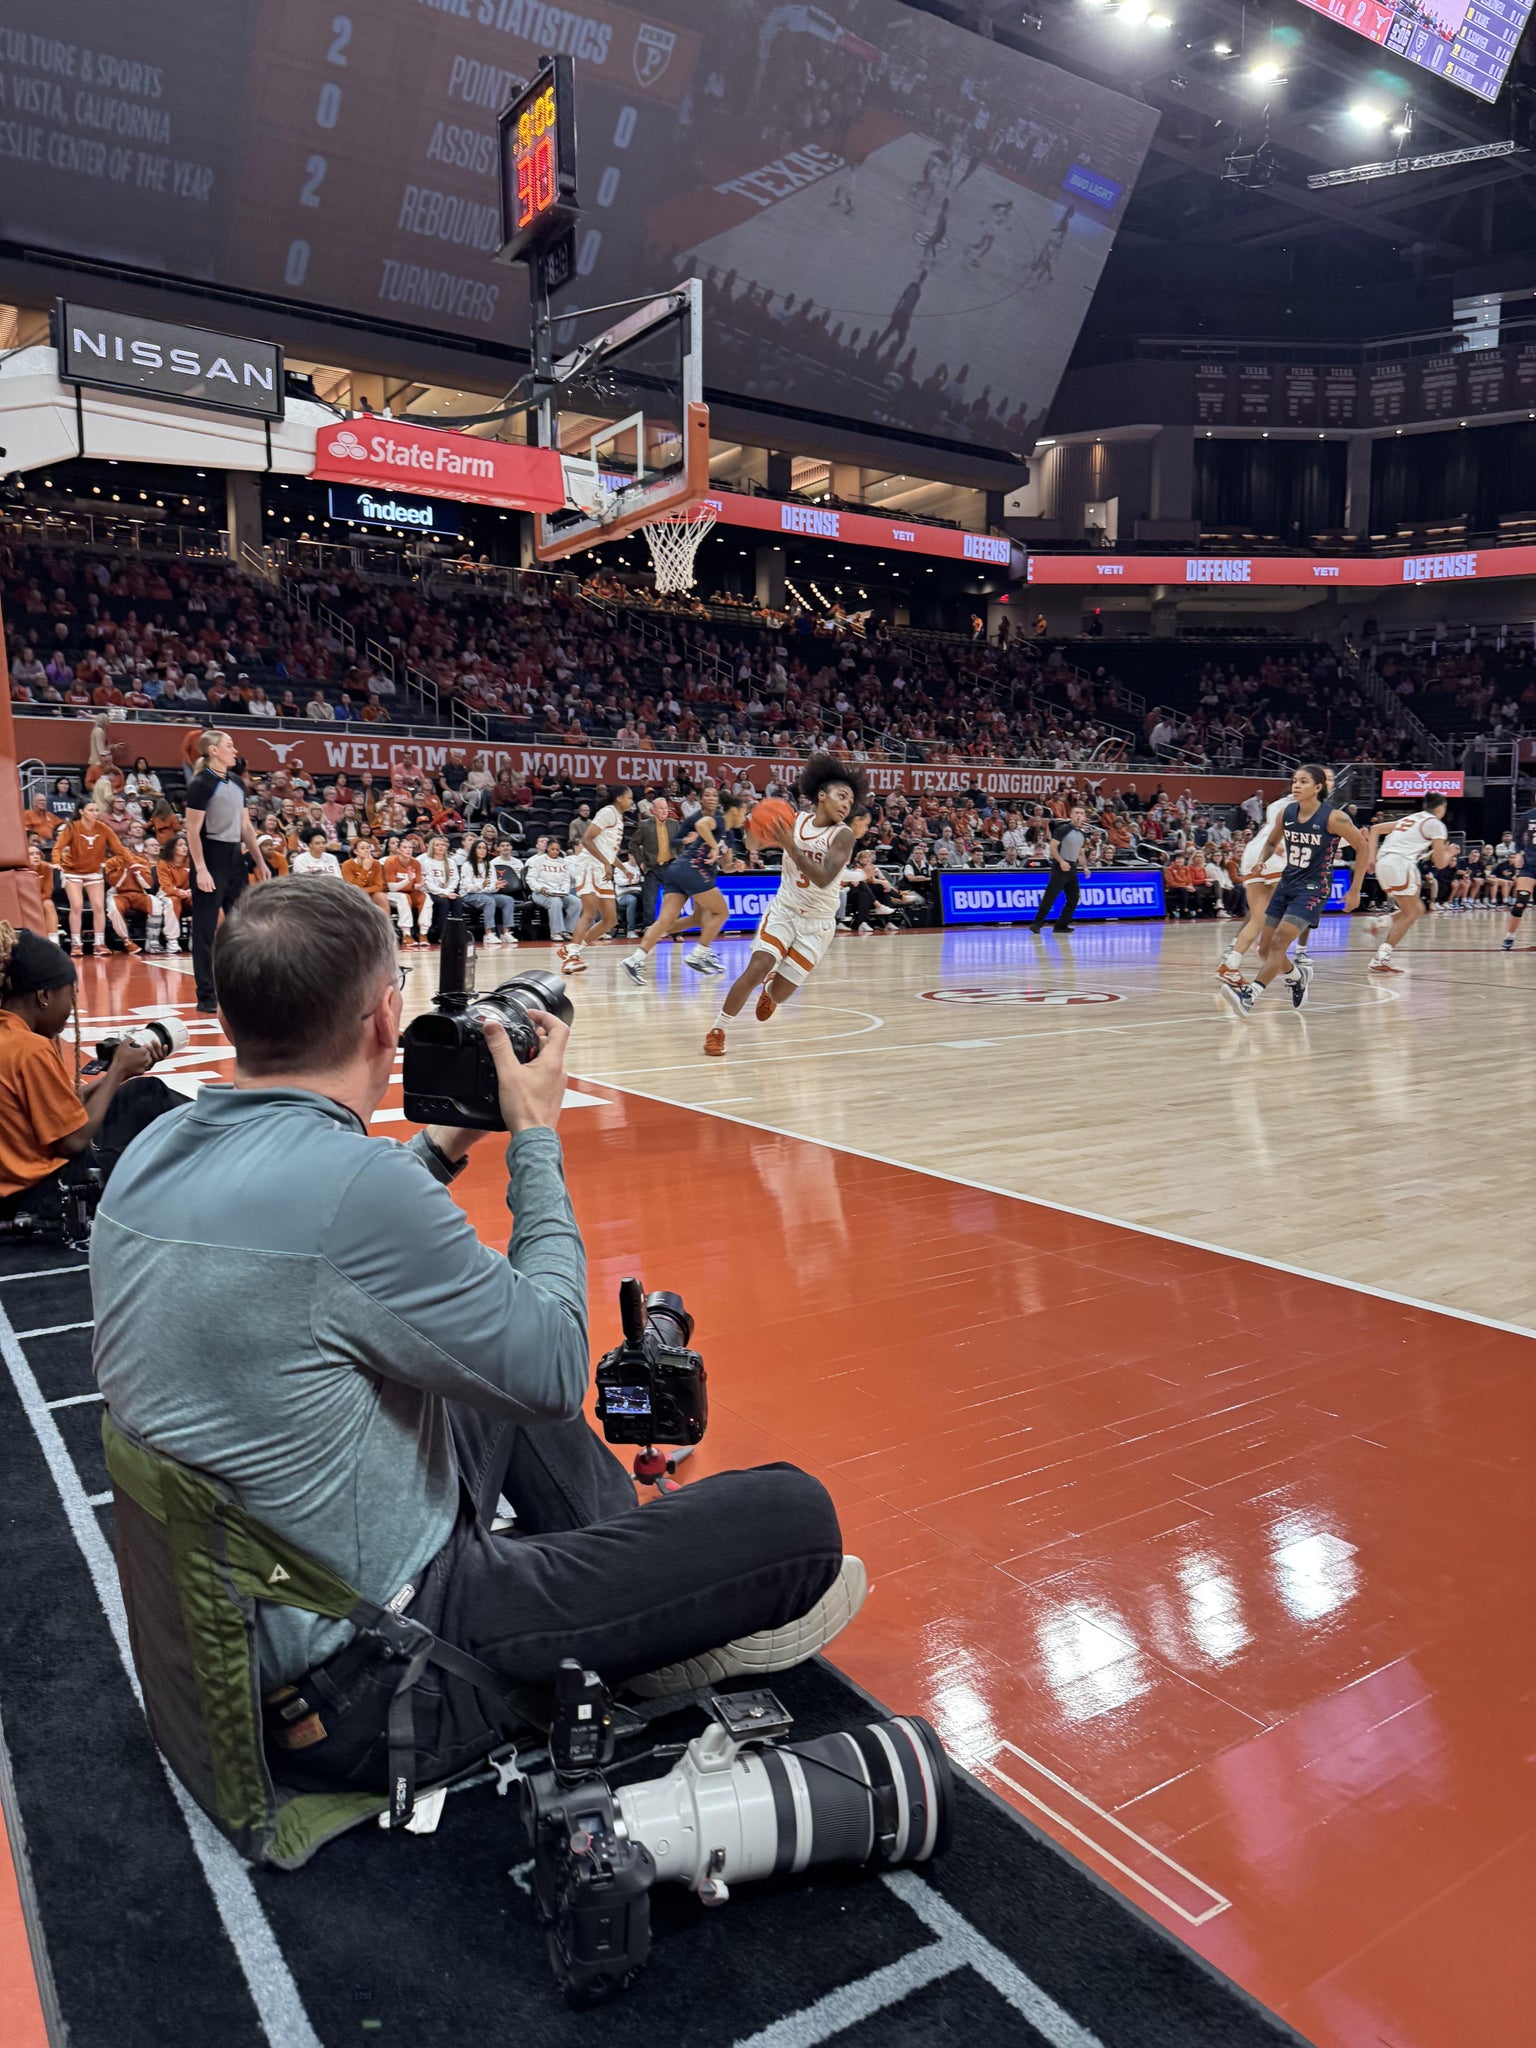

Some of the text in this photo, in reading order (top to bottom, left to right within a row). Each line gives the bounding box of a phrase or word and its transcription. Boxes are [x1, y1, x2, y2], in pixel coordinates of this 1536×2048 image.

[1353, 1, 1367, 27] 2
[327, 15, 353, 67] 2
[477, 0, 613, 64] STATISTICS
[1430, 43, 1444, 68] 0
[97, 52, 163, 98] SPORTS
[74, 90, 171, 144] CALIFORNIA
[316, 82, 342, 129] 0
[613, 105, 638, 149] 0
[300, 154, 328, 208] 2
[516, 135, 557, 228] 30
[596, 165, 621, 208] 0
[398, 184, 501, 252] REBOUND
[284, 239, 312, 287] 0
[378, 258, 500, 323] TURNOVERS
[73, 328, 273, 391] NISSAN
[357, 493, 433, 526] indeed
[781, 504, 840, 538] DEFENSE
[892, 529, 915, 542] YETI
[1096, 565, 1125, 575] YETI
[1186, 559, 1251, 582] DEFENSE
[1312, 566, 1339, 577] YETI
[1402, 553, 1478, 581] DEFENSE
[520, 751, 608, 779] MOODY
[617, 756, 708, 783] CENTER
[866, 768, 904, 790] THE
[911, 770, 970, 794] TEXAS
[1385, 780, 1461, 790] LONGHORN
[1284, 829, 1322, 846] PENN
[1288, 845, 1312, 869] 22
[722, 894, 777, 915] LIGH
[954, 890, 993, 910] BUD
[1077, 886, 1154, 906] UD LIGHT
